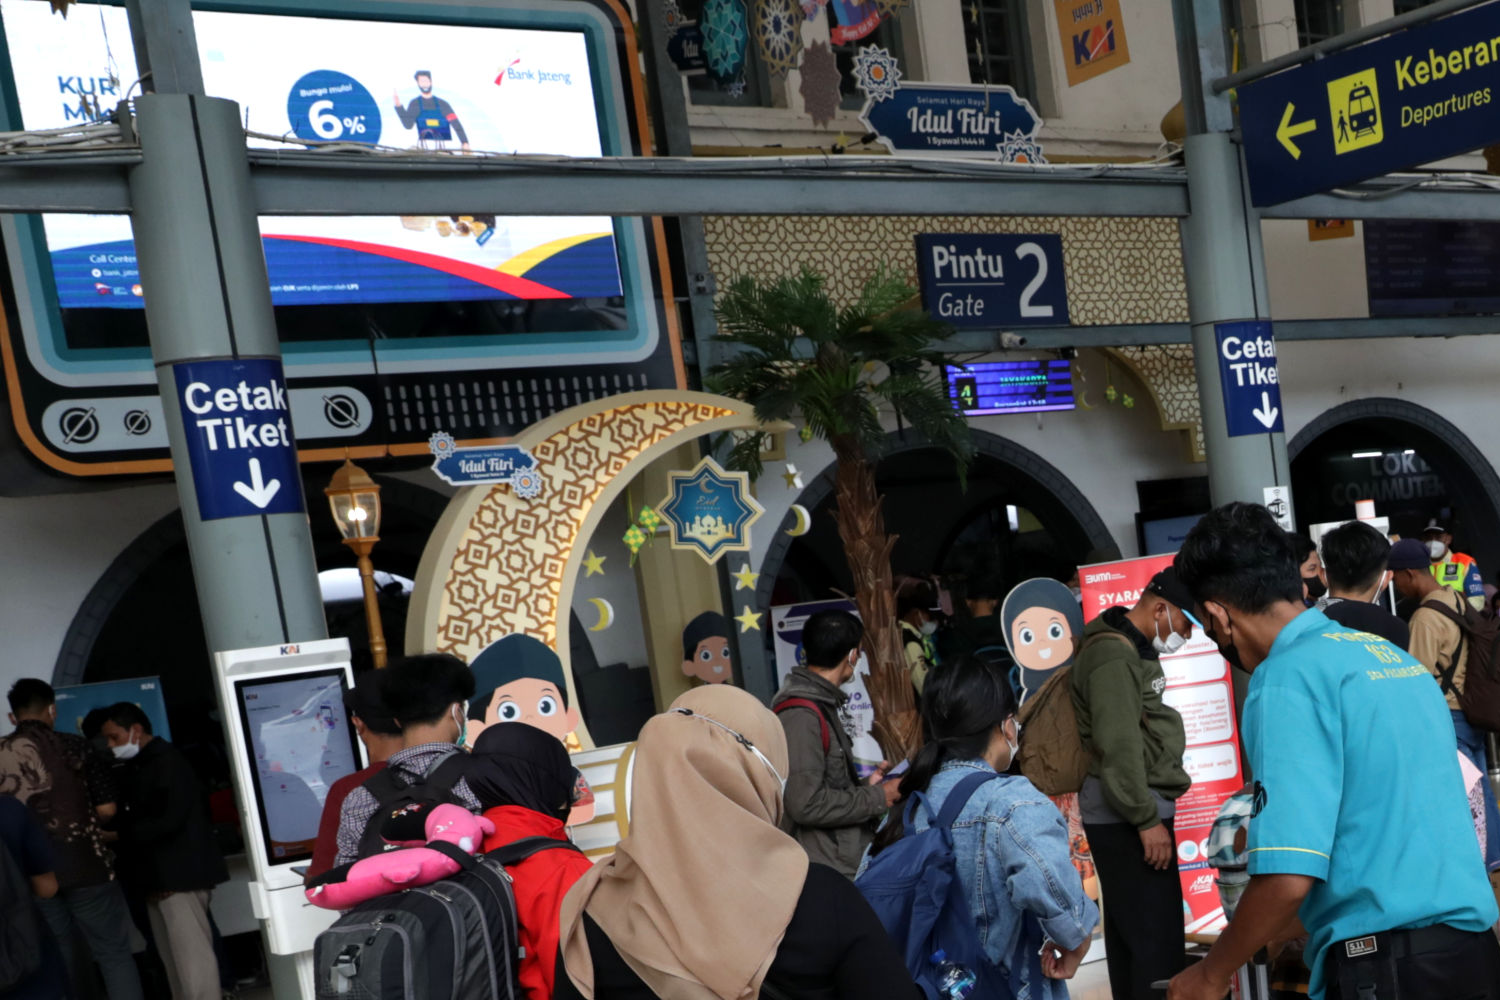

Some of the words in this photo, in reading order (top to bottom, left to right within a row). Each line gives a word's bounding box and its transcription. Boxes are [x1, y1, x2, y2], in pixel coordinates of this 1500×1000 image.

[682, 38, 699, 57] Idu
[1072, 19, 1115, 66] KAI
[507, 67, 535, 80] Bank
[57, 75, 117, 96] KUR
[917, 96, 949, 105] Selamat
[950, 97, 966, 106] Hari
[1401, 87, 1492, 128] Departures
[907, 106, 953, 135] Idul
[957, 107, 1001, 135] Fitri
[932, 137, 960, 146] Syawal
[932, 244, 1004, 279] Pintu
[1014, 241, 1055, 318] 2
[938, 292, 985, 317] Gate
[184, 379, 288, 415] Cetak
[196, 417, 290, 451] Tiket
[279, 644, 300, 656] KAI
[1363, 643, 1403, 664] 163
